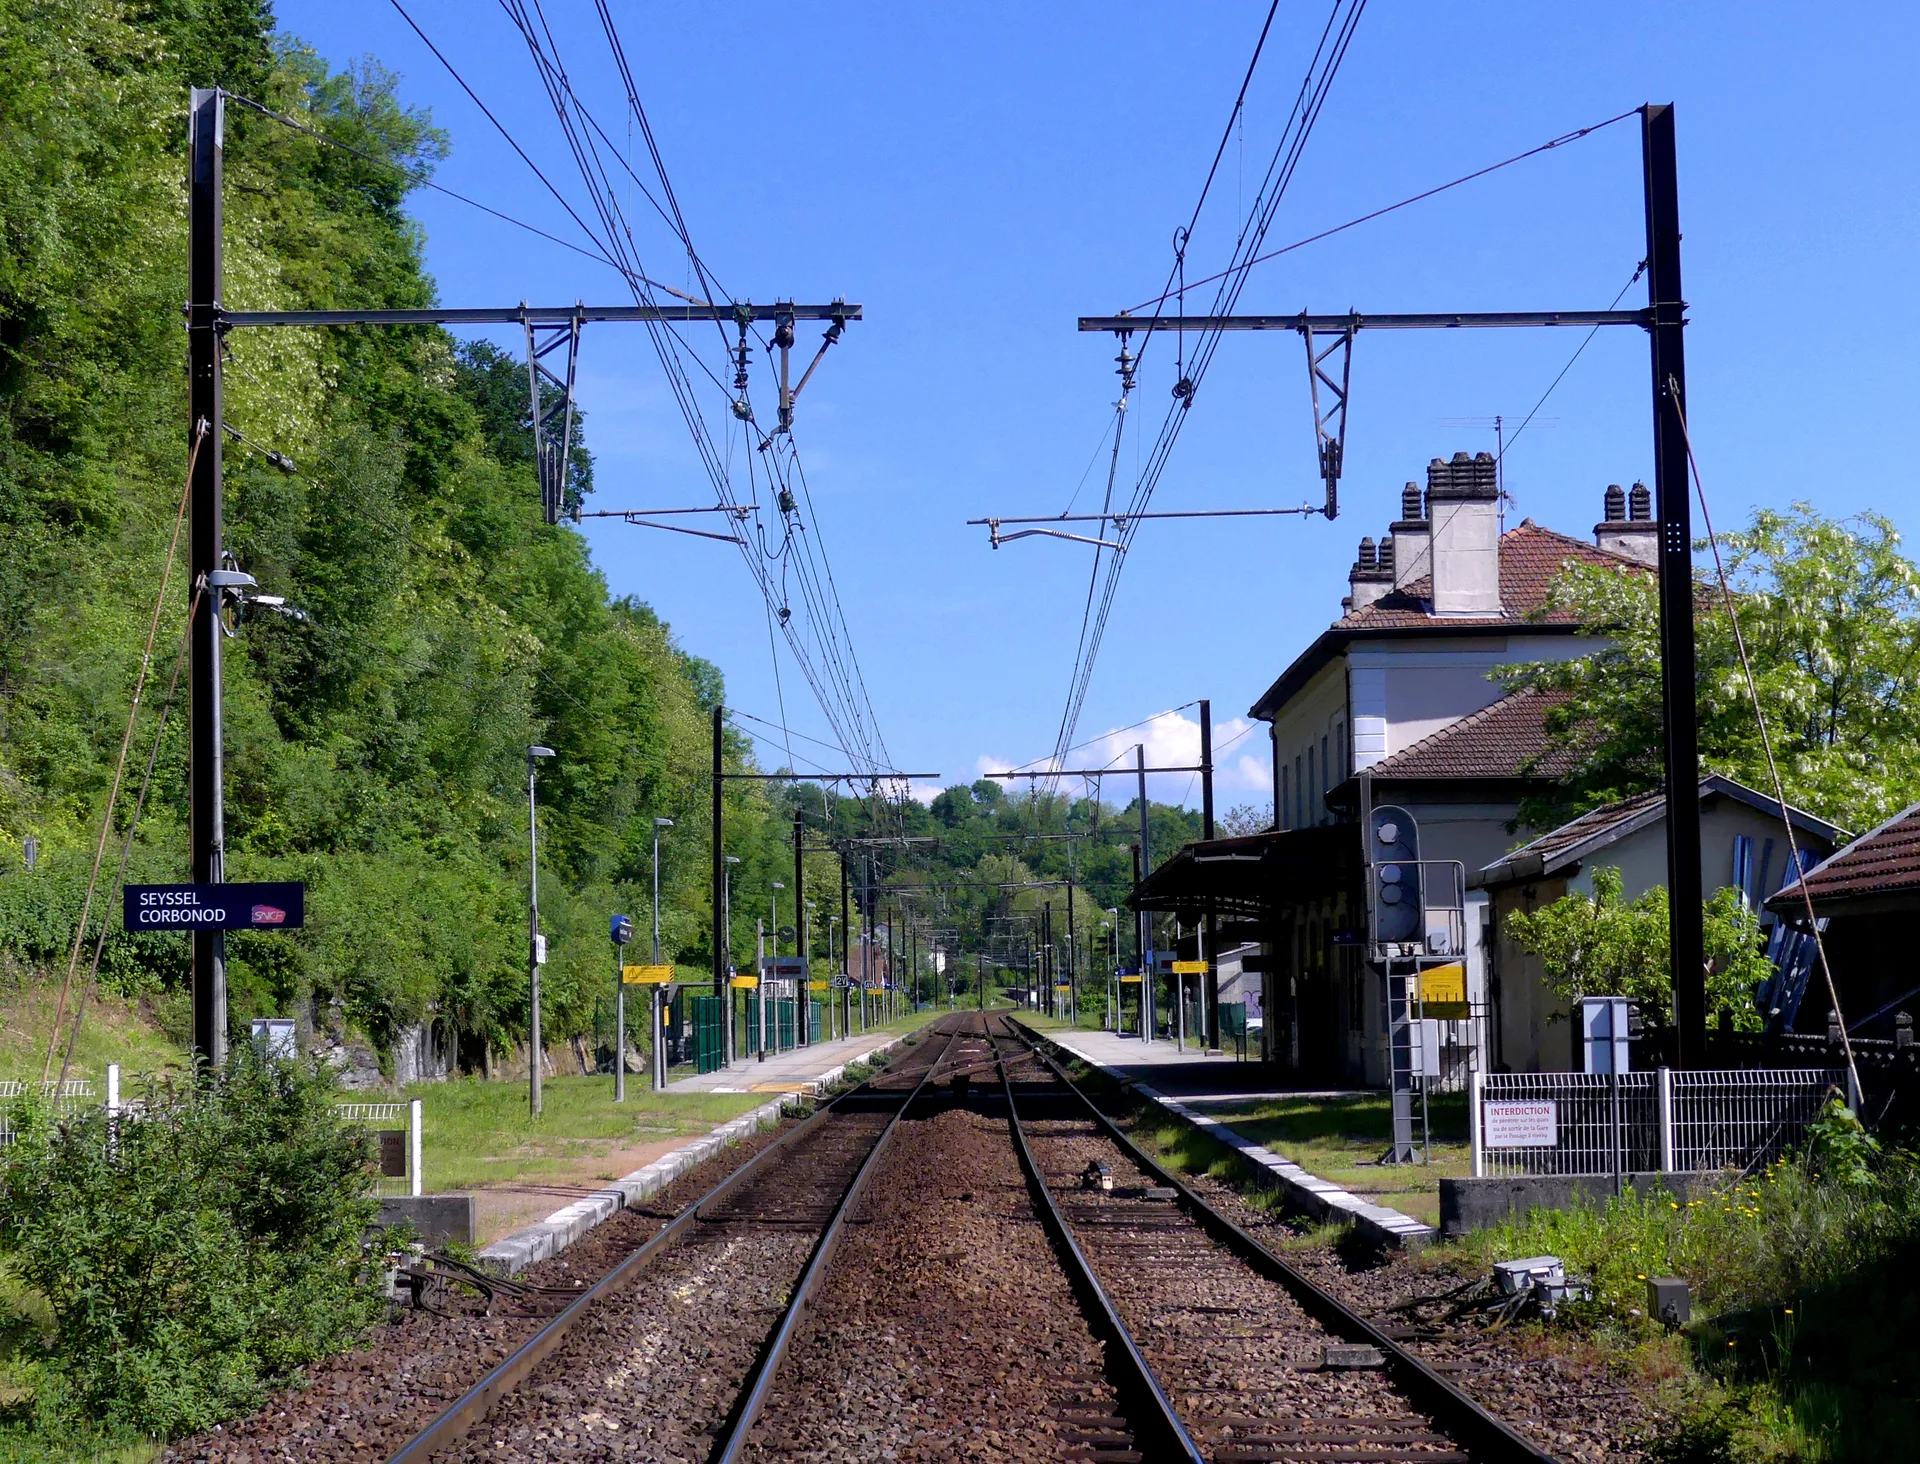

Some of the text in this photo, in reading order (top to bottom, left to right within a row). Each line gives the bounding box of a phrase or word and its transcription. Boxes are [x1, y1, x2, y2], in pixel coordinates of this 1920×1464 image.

[140, 892, 200, 905] SEYSSEL
[139, 909, 226, 923] CORBONOD
[253, 911, 284, 921] SNCF
[836, 977, 846, 985] 2V
[1491, 1107, 1550, 1116] INTERDICTION
